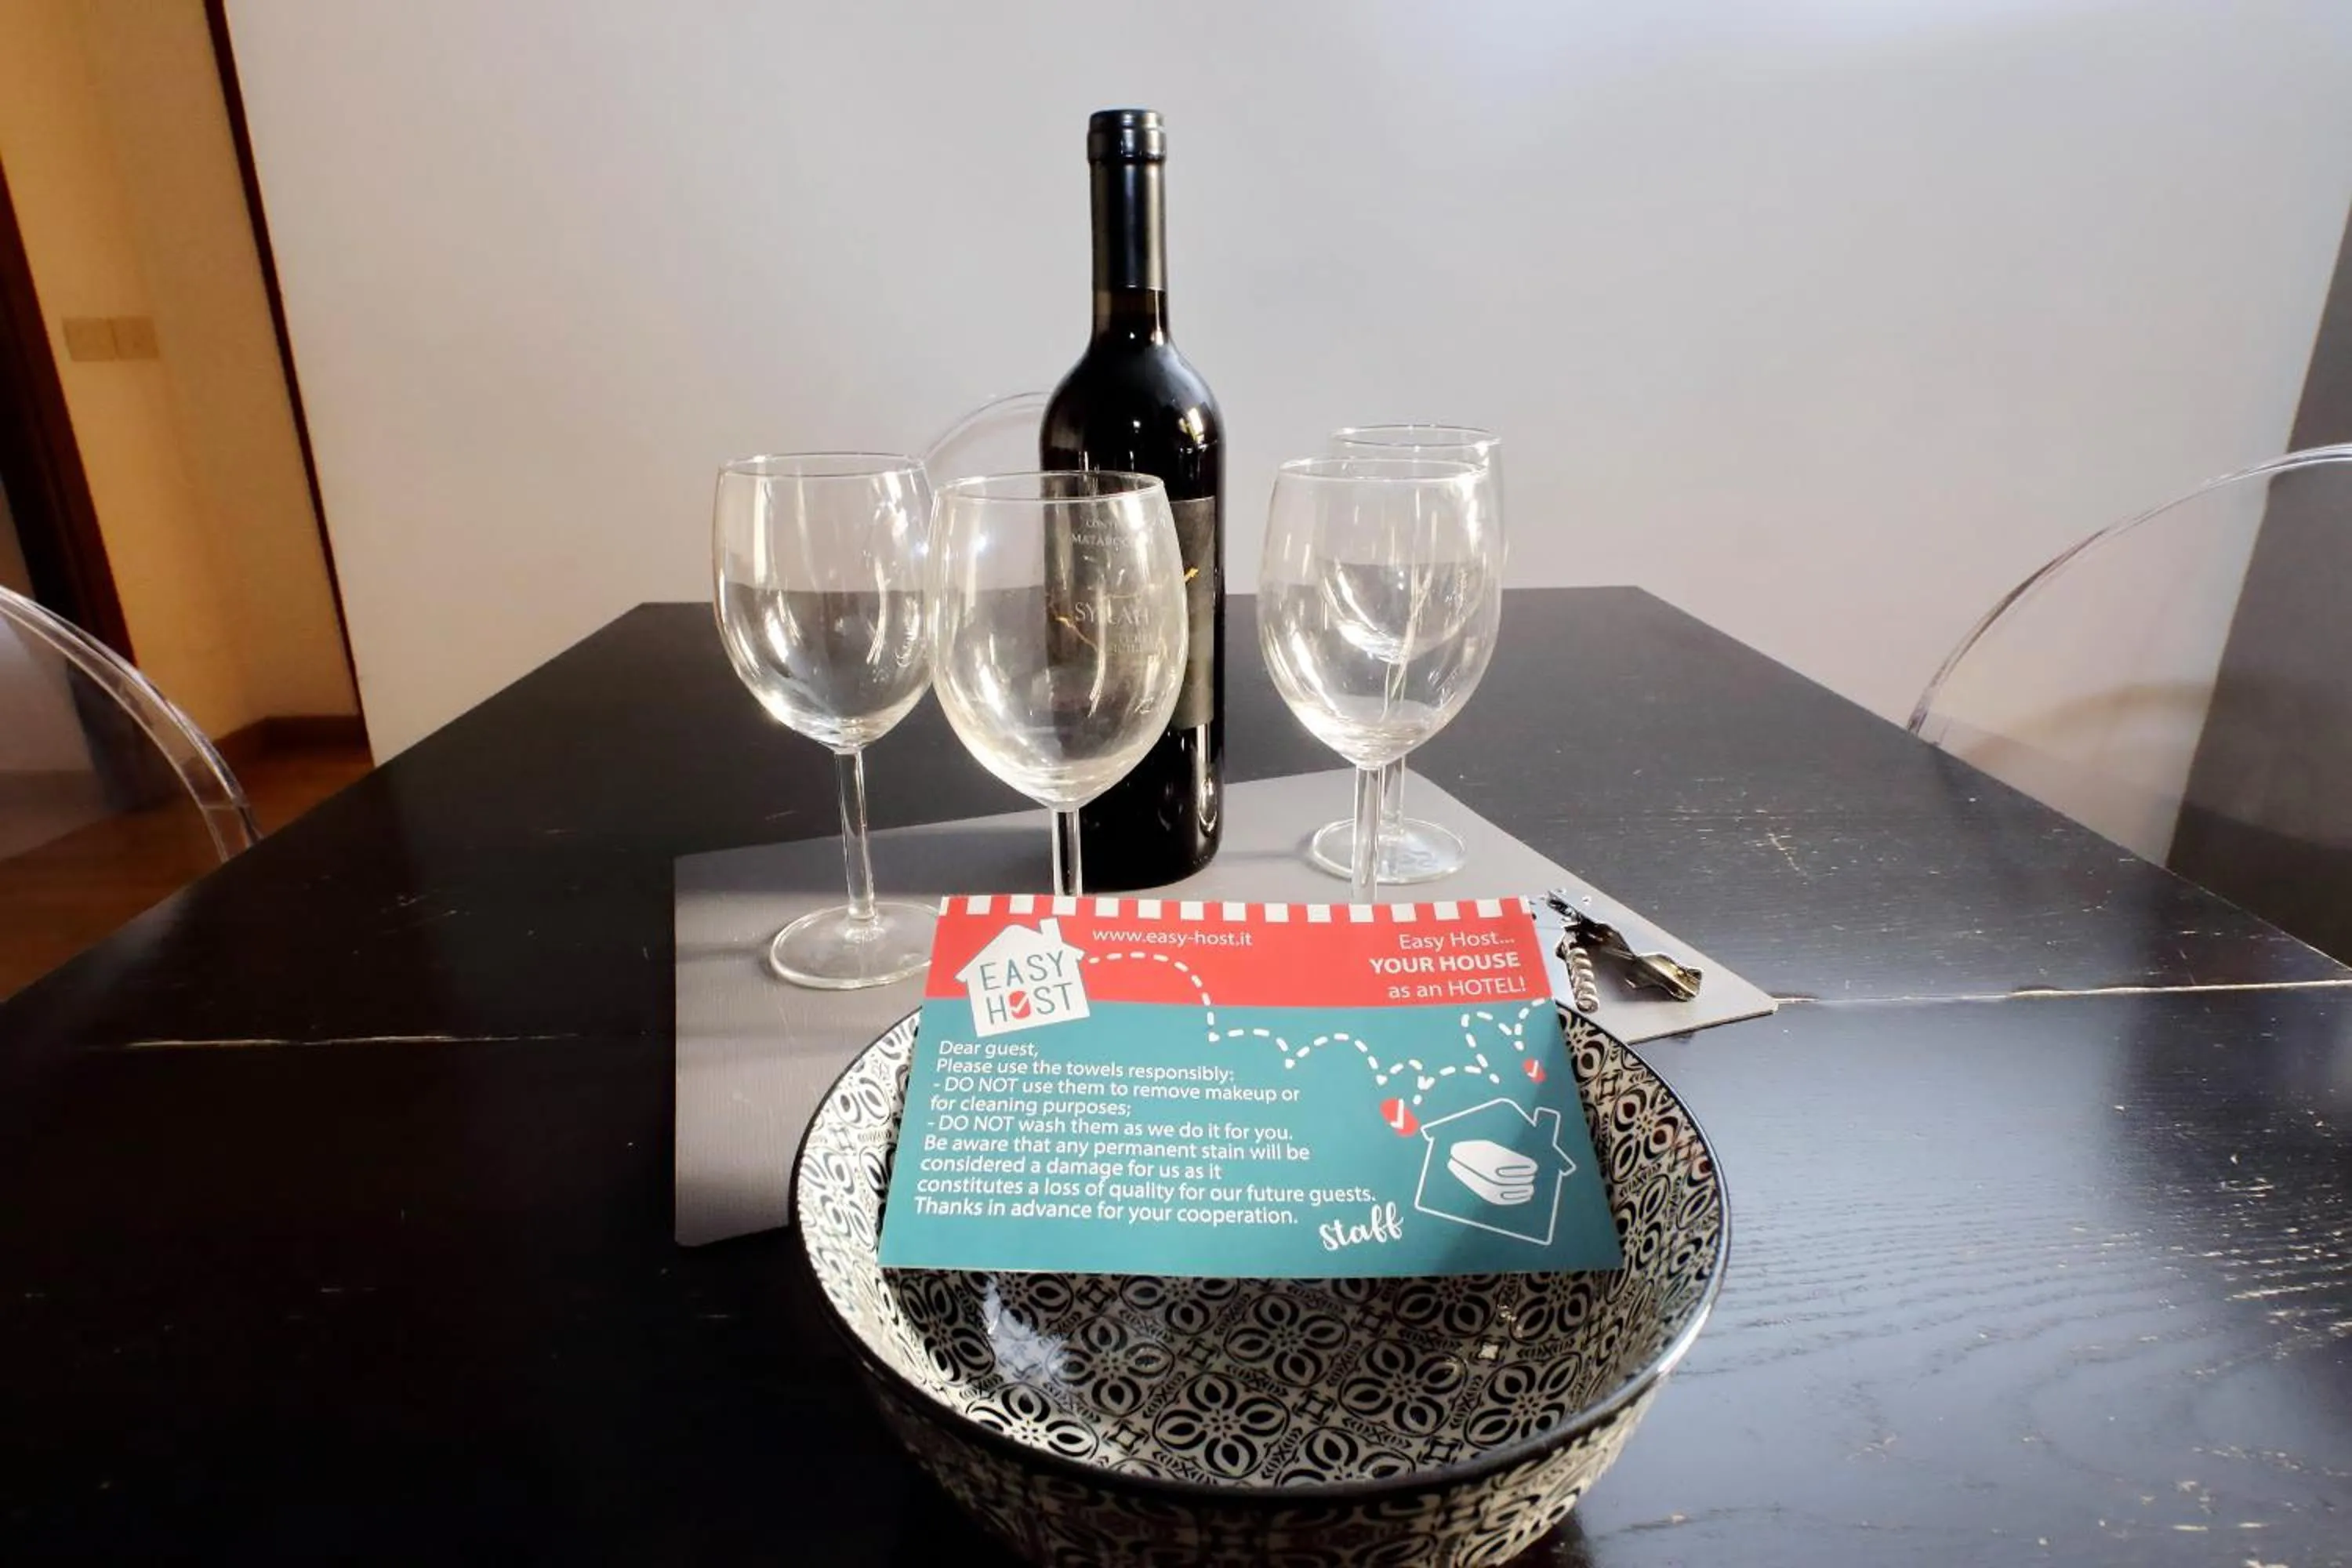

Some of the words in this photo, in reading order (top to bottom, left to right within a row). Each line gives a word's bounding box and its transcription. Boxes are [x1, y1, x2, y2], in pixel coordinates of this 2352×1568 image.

[1093, 930, 1251, 947] www.easy-host.it
[1399, 935, 1443, 952] Easy
[1450, 931, 1514, 947] Host...
[978, 950, 1065, 991] EASY
[1370, 957, 1434, 973] YOUR
[1439, 952, 1519, 971] HOUSE
[1389, 985, 1410, 998] as
[1417, 984, 1442, 997] an
[1449, 977, 1526, 996] HOTEL!
[939, 1041, 981, 1054] Dear
[985, 1043, 1038, 1058] guest,
[937, 1058, 993, 1073] Please
[997, 1062, 1028, 1074] use
[1033, 1060, 1062, 1075] the
[1066, 1062, 1123, 1077] towels
[1129, 1066, 1233, 1083] responsibly:
[946, 1076, 974, 1091] DO
[978, 1077, 1018, 1092] NOT
[1022, 1082, 1053, 1093] use
[1058, 1079, 1104, 1094] them
[1110, 1083, 1127, 1096] to
[1134, 1086, 1200, 1099] remove
[1206, 1085, 1277, 1104] makeup
[1281, 1090, 1299, 1101] or
[931, 1094, 956, 1111] for
[960, 1096, 1037, 1116] cleaning
[1043, 1102, 1131, 1116] purposes;
[939, 1115, 968, 1131] DO
[974, 1116, 1014, 1131] NOT
[1019, 1117, 1065, 1133] wash
[1071, 1118, 1118, 1134] them
[1124, 1124, 1142, 1135] as
[1148, 1124, 1174, 1137] we
[1179, 1122, 1203, 1138] do
[1208, 1123, 1220, 1138] it
[1225, 1123, 1249, 1139] for
[1254, 1127, 1292, 1143] you.
[924, 1134, 947, 1150] Be
[952, 1139, 1008, 1151] aware
[1014, 1136, 1051, 1152] that
[1056, 1142, 1088, 1157] any
[1094, 1142, 1197, 1158] permanent
[1201, 1144, 1244, 1159] stain
[1250, 1144, 1280, 1160] will
[1287, 1144, 1309, 1160] be
[921, 1156, 1025, 1173] considered
[1030, 1161, 1040, 1173] a
[1047, 1157, 1123, 1181] damage
[1127, 1160, 1154, 1176] for
[1160, 1166, 1179, 1178] us
[1185, 1167, 1203, 1178] as
[1210, 1163, 1221, 1179] it
[917, 1177, 1022, 1194] constitutes
[1029, 1182, 1039, 1195] a
[1044, 1178, 1080, 1196] loss
[1085, 1178, 1105, 1196] of
[1109, 1182, 1174, 1203] quality
[1179, 1182, 1205, 1200] for
[1210, 1189, 1242, 1201] our
[1247, 1185, 1304, 1201] future
[1308, 1187, 1375, 1206] guests.
[915, 1196, 982, 1215] Thanks
[988, 1200, 1005, 1215] in
[1011, 1200, 1091, 1218] advance
[1098, 1201, 1123, 1219] for
[1129, 1207, 1172, 1223] your
[1177, 1207, 1297, 1226] cooperation.
